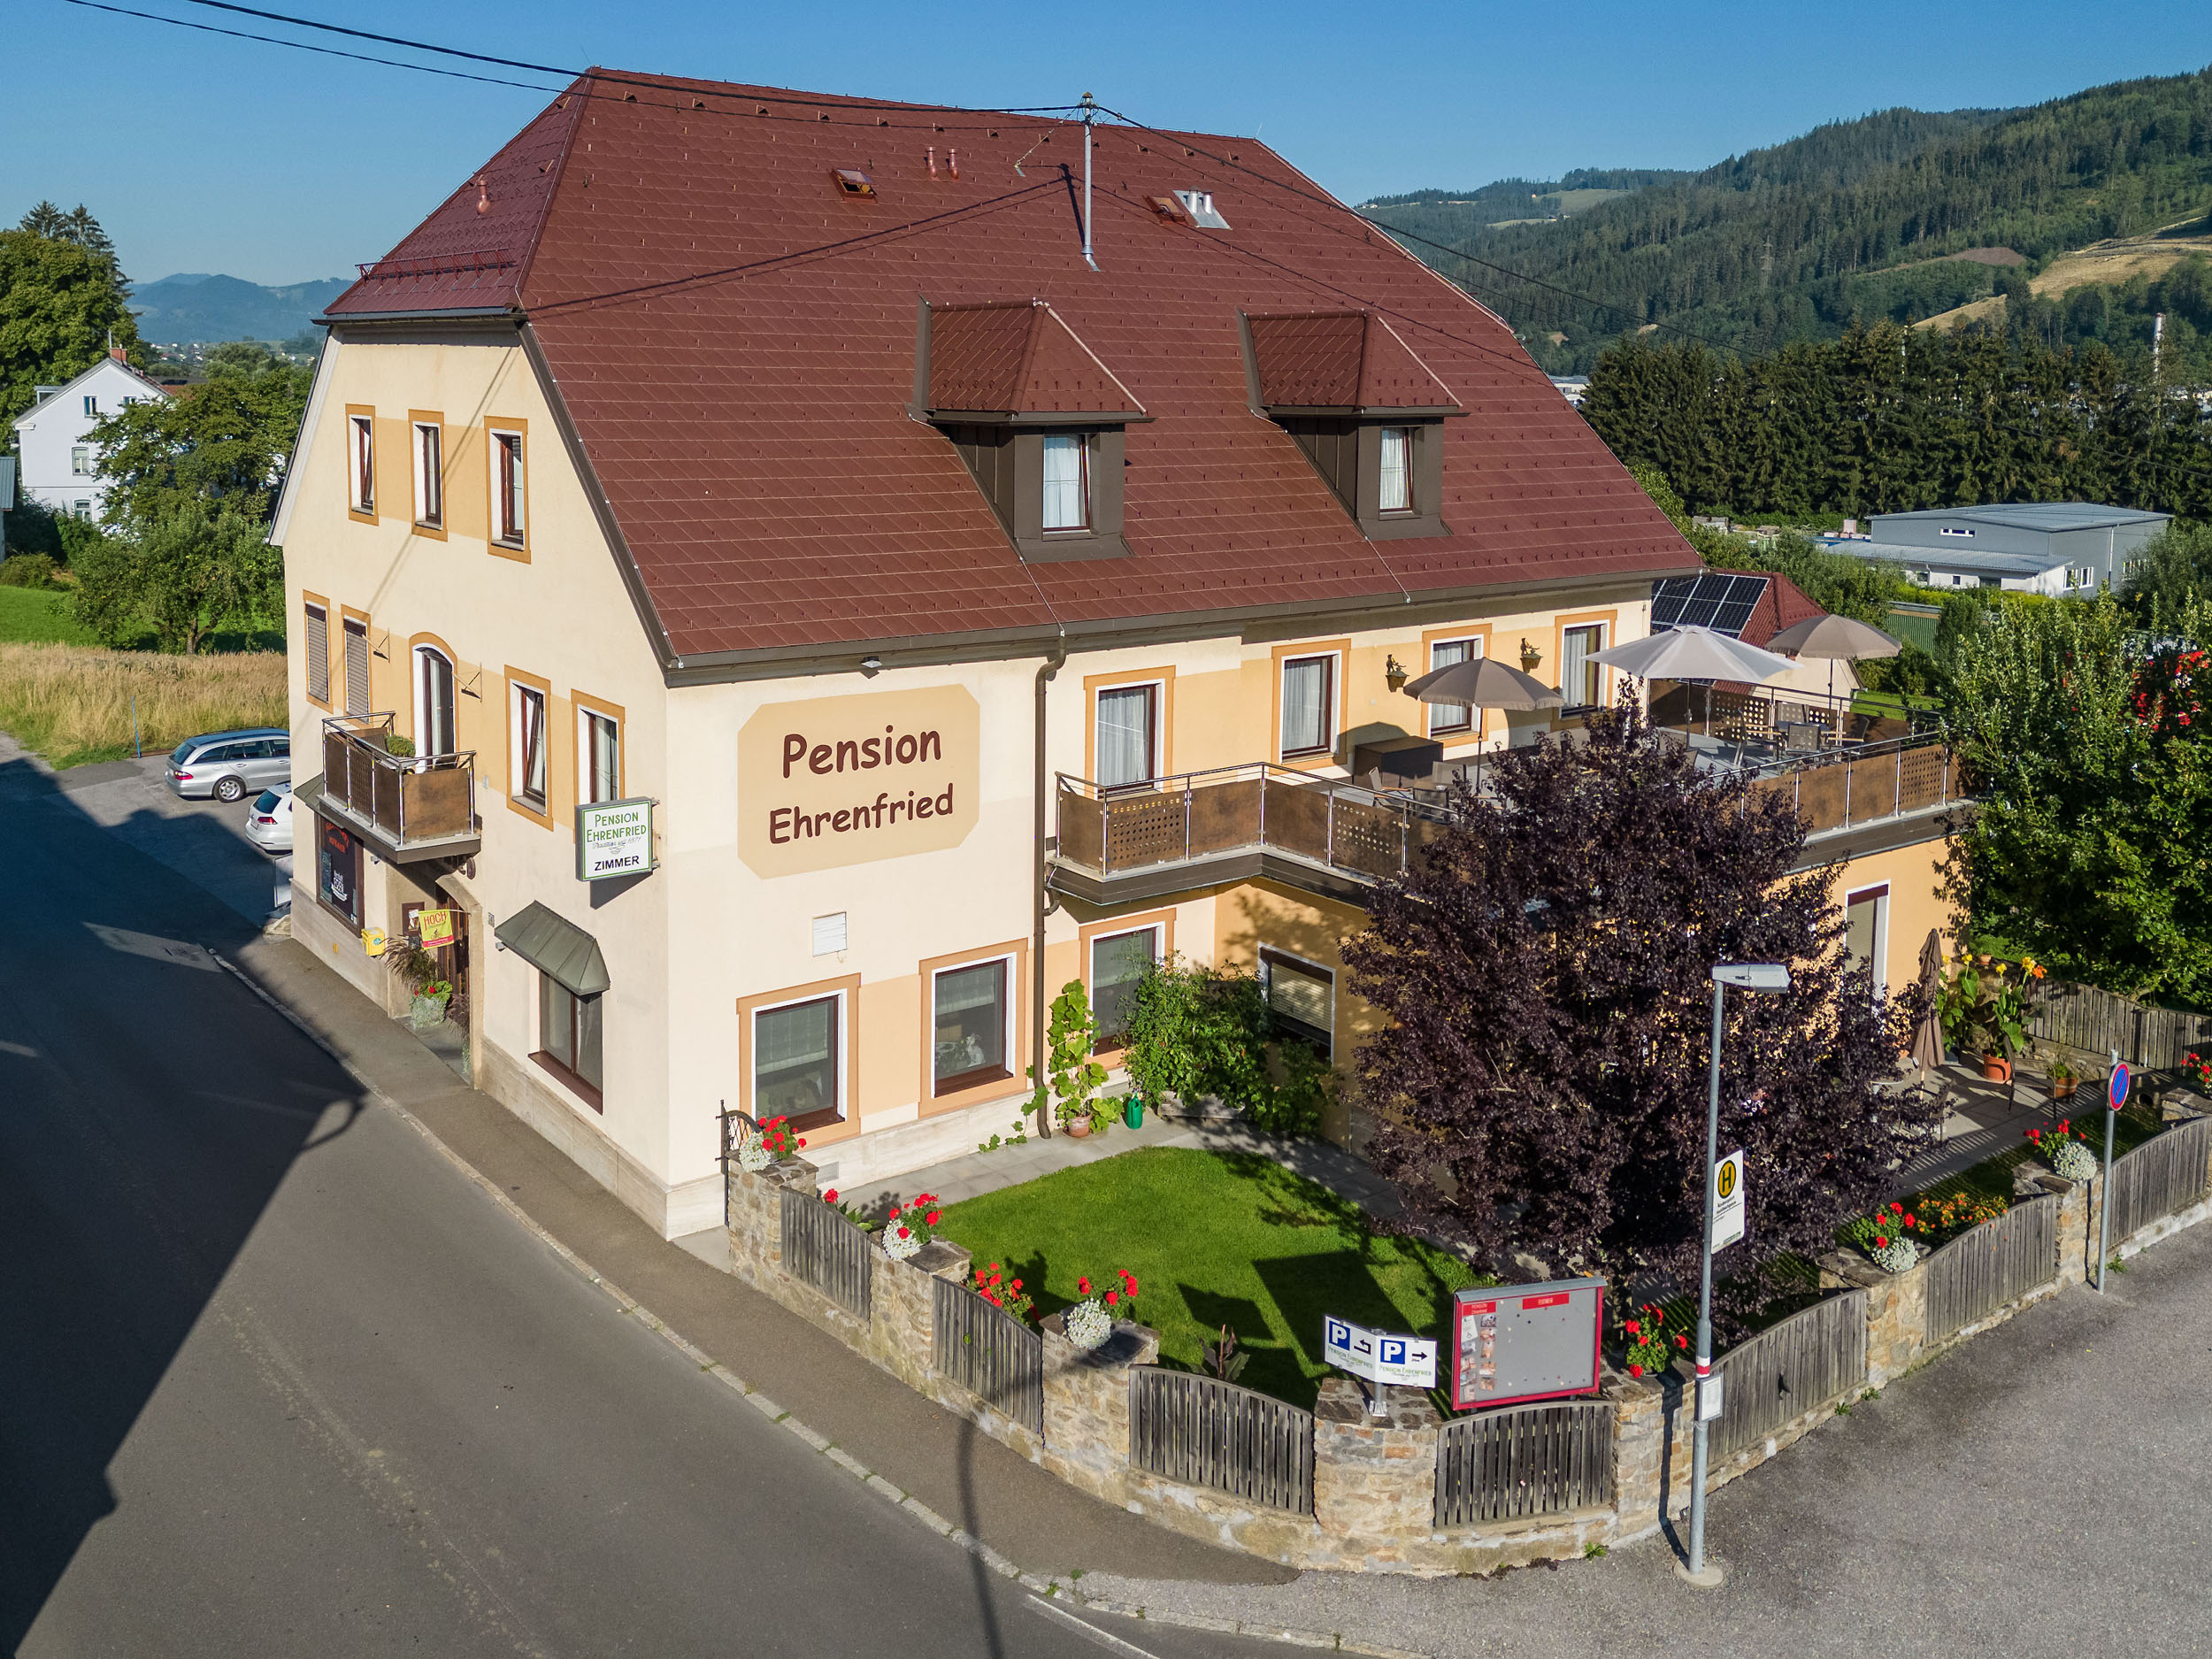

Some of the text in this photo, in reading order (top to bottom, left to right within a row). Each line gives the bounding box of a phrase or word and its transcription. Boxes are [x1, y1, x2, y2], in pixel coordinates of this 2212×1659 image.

[782, 724, 941, 779] Pension
[595, 811, 639, 827] PENSION
[769, 782, 954, 844] Ehrenfried
[587, 825, 647, 842] EHRENFRIED
[595, 856, 640, 871] ZIMMER
[423, 910, 447, 931] HOCH
[1722, 1166, 1732, 1193] H
[1332, 1324, 1348, 1344] P
[1384, 1341, 1402, 1362] P
